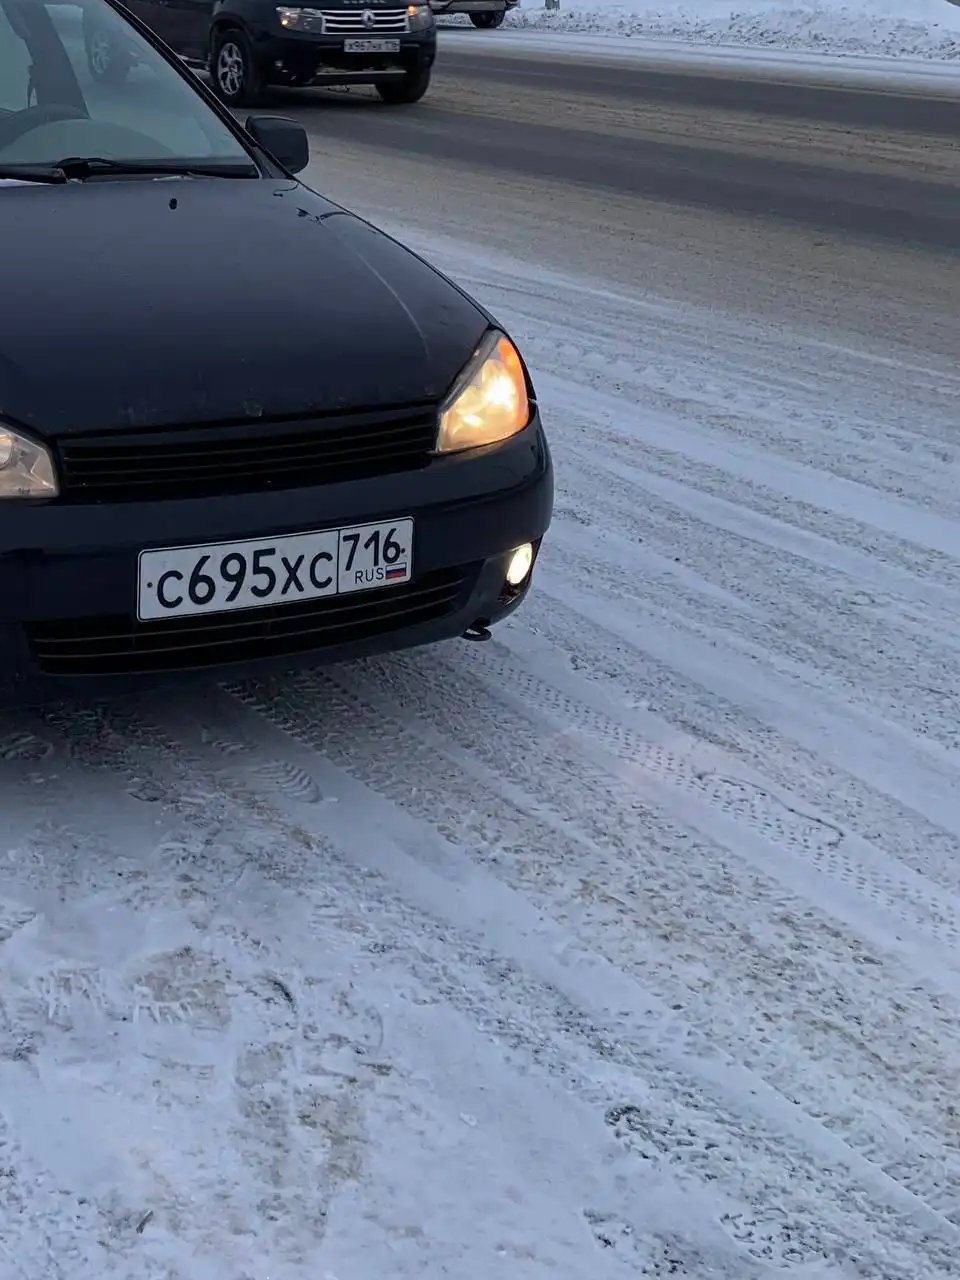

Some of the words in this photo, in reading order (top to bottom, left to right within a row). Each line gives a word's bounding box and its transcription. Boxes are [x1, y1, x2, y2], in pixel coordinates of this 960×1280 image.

[156, 548, 333, 608] С695ХС
[342, 528, 402, 571] 716
[354, 567, 384, 584] RUS
